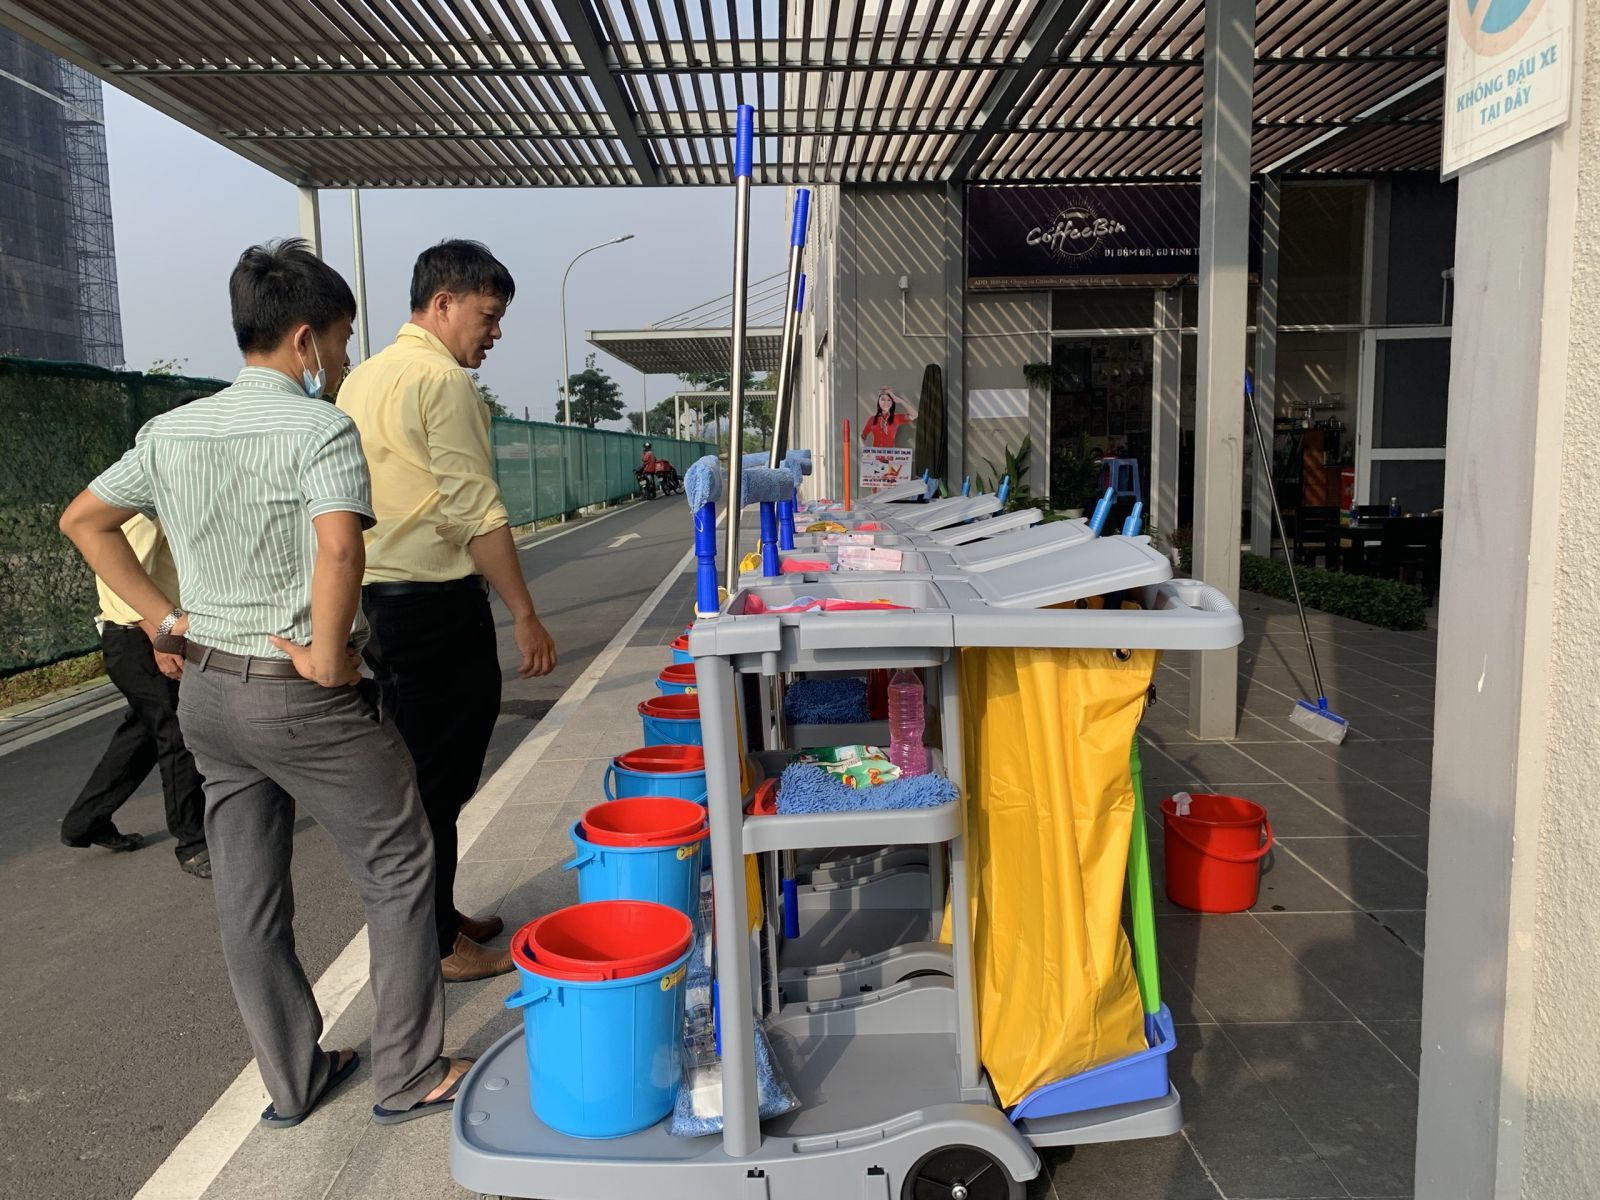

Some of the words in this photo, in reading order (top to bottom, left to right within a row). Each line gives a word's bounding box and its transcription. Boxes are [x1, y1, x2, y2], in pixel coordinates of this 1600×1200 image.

[1456, 74, 1503, 113] KHÔNG
[1540, 44, 1558, 70] XE
[1480, 101, 1501, 125] TẠI
[1504, 85, 1532, 114] ĐÂY
